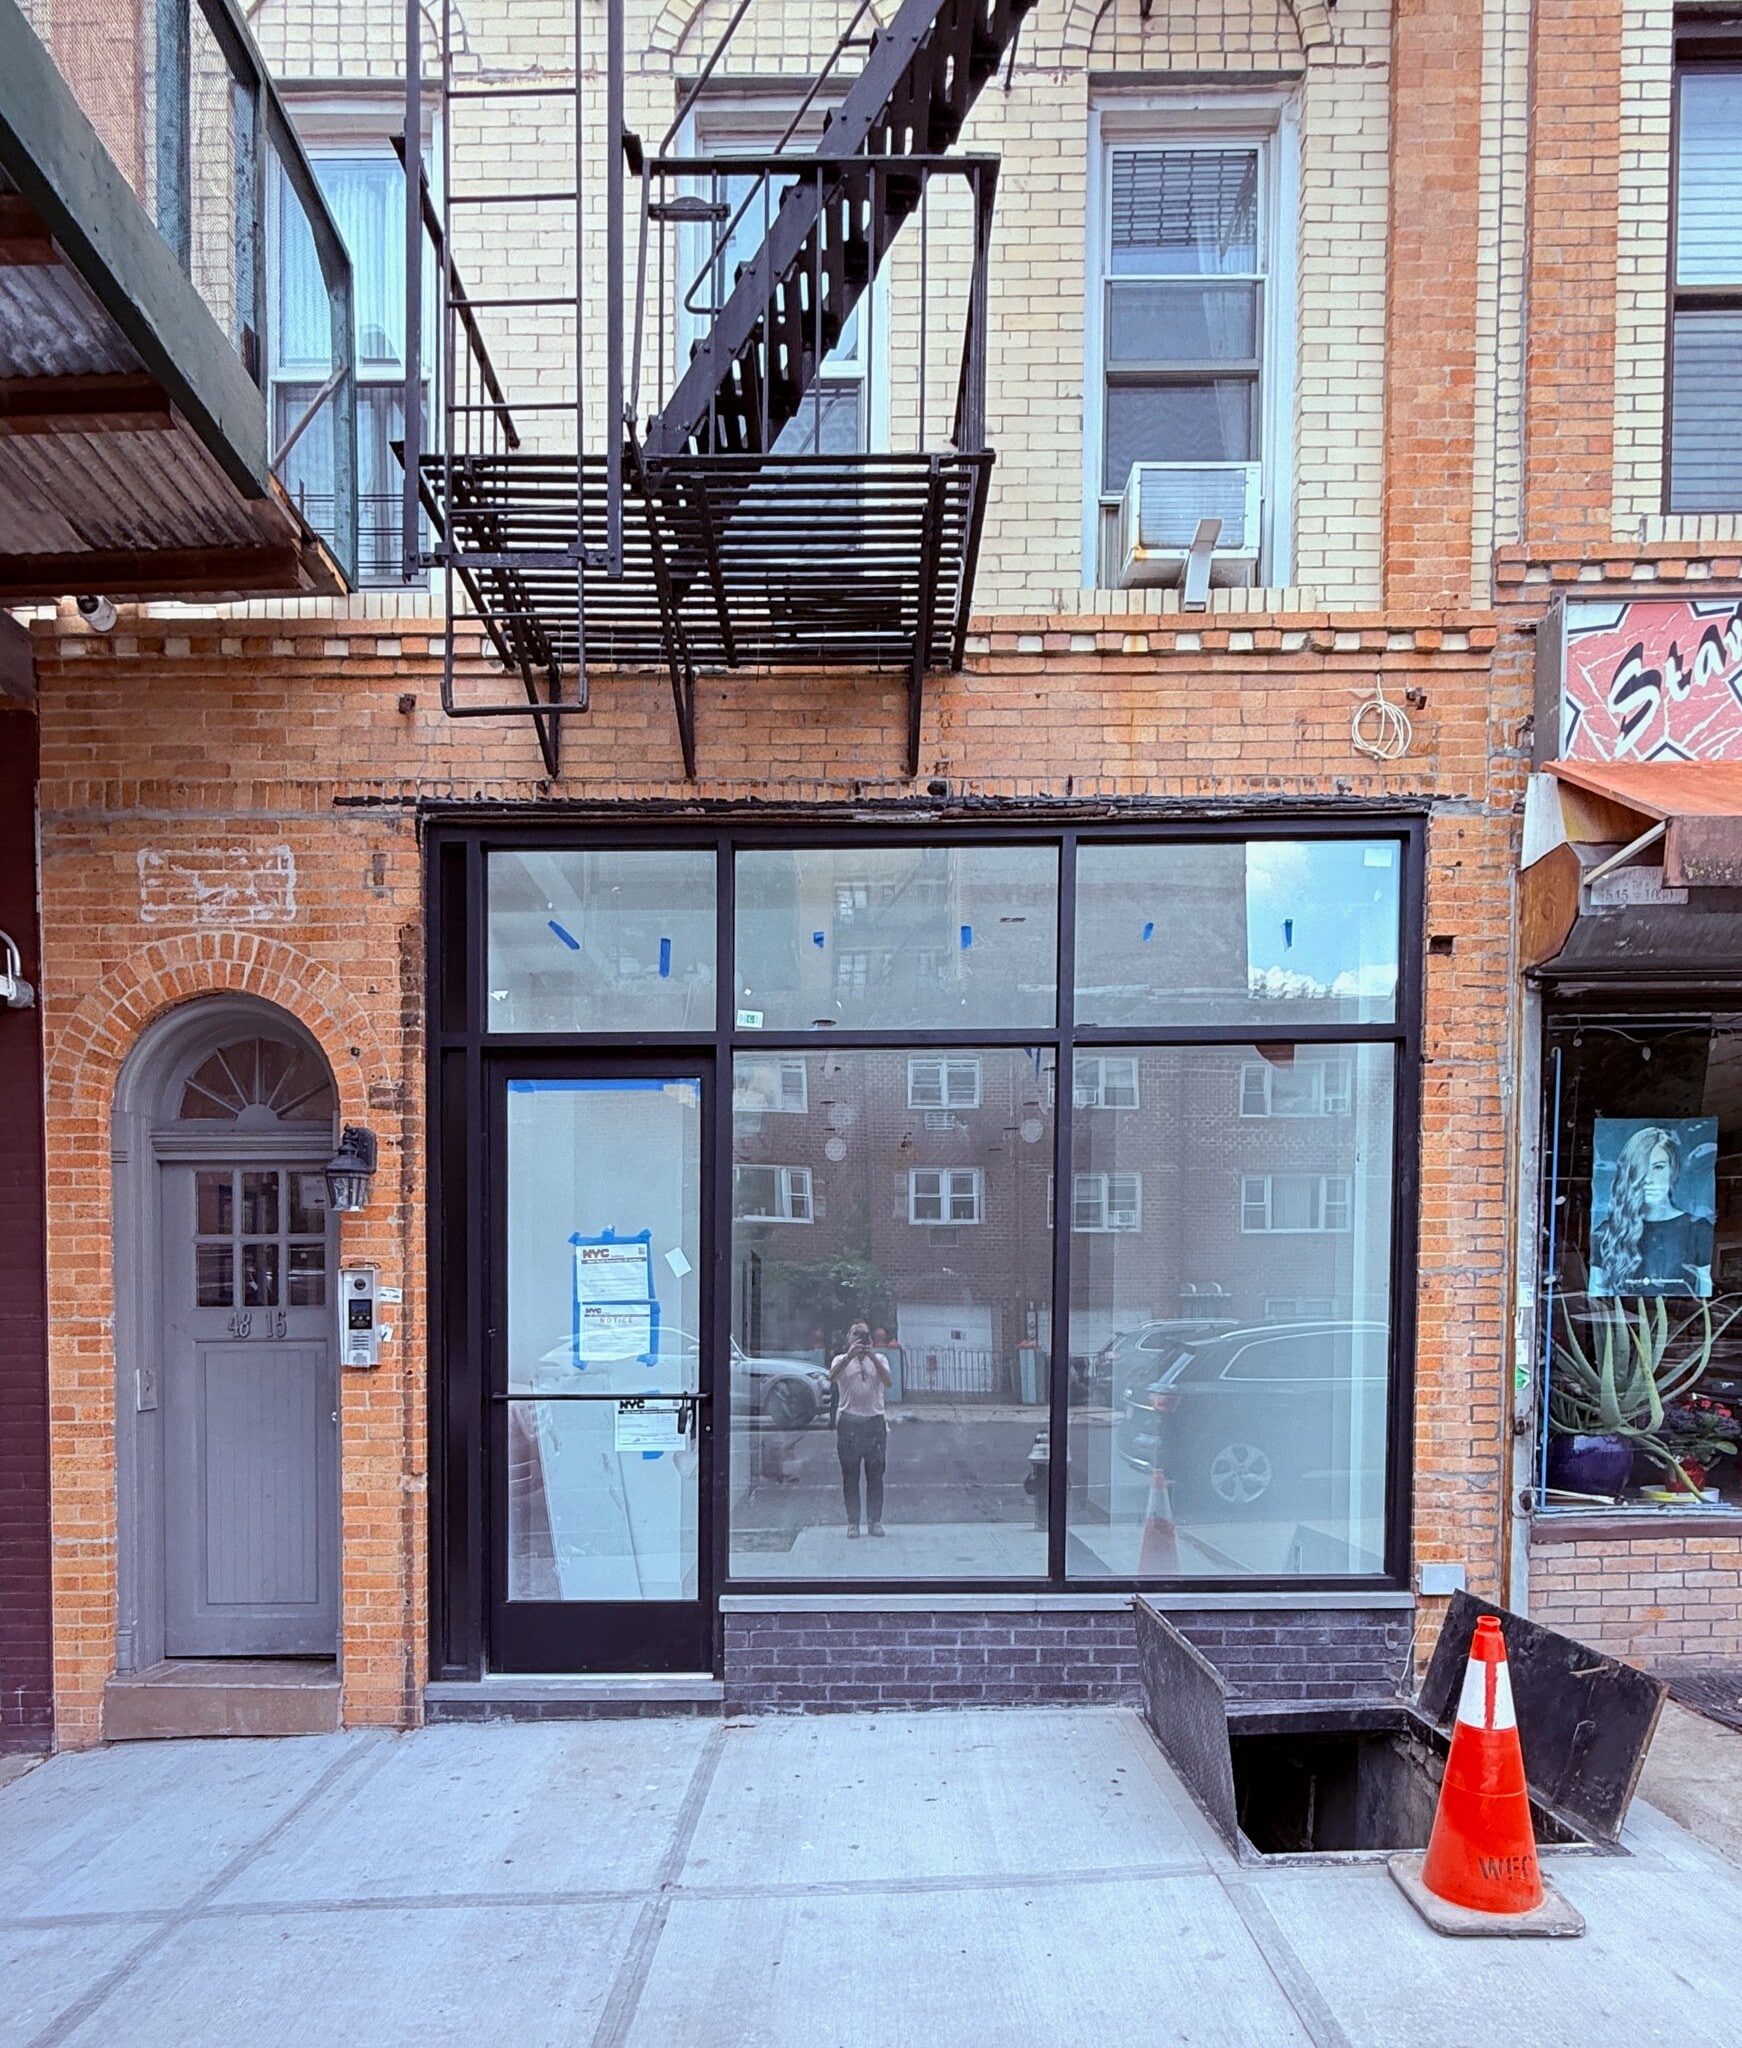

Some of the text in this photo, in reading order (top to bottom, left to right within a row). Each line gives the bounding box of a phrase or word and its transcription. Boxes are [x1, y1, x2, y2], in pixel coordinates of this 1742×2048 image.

[583, 1249, 609, 1258] NYC
[228, 1311, 288, 1338] 48 15
[619, 1400, 645, 1409] NYC
